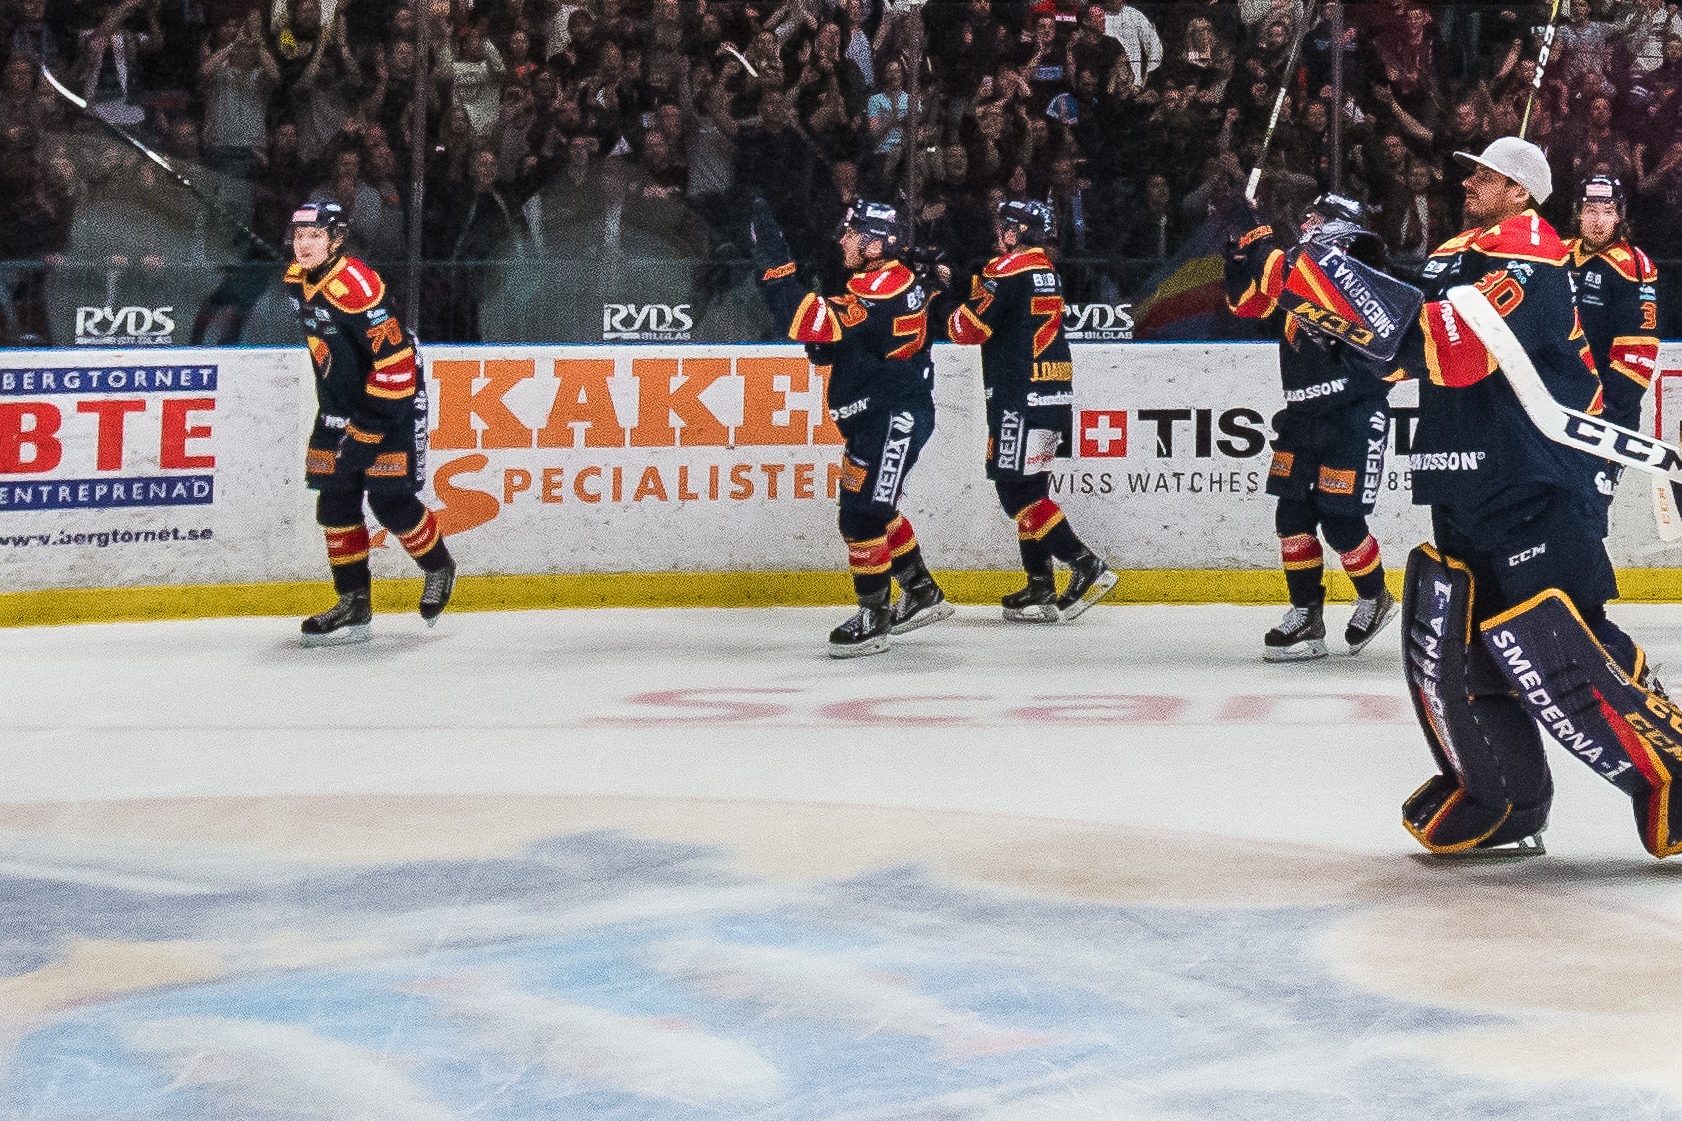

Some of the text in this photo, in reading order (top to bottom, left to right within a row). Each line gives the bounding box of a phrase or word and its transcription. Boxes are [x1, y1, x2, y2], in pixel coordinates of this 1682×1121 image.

[603, 303, 693, 332] RYDS
[1331, 264, 1399, 340] SMEDERNA
[74, 305, 176, 337] RYDS
[1295, 299, 1376, 347] CCM
[2, 368, 213, 391] BERGTORNET
[0, 398, 216, 474] BTE
[1129, 471, 1259, 494] WATCHES
[1361, 436, 1386, 505] REFIX
[0, 480, 210, 506] ENTREPRENAD
[1507, 542, 1547, 568] CCM
[1492, 628, 1605, 765] SMEDERNA
